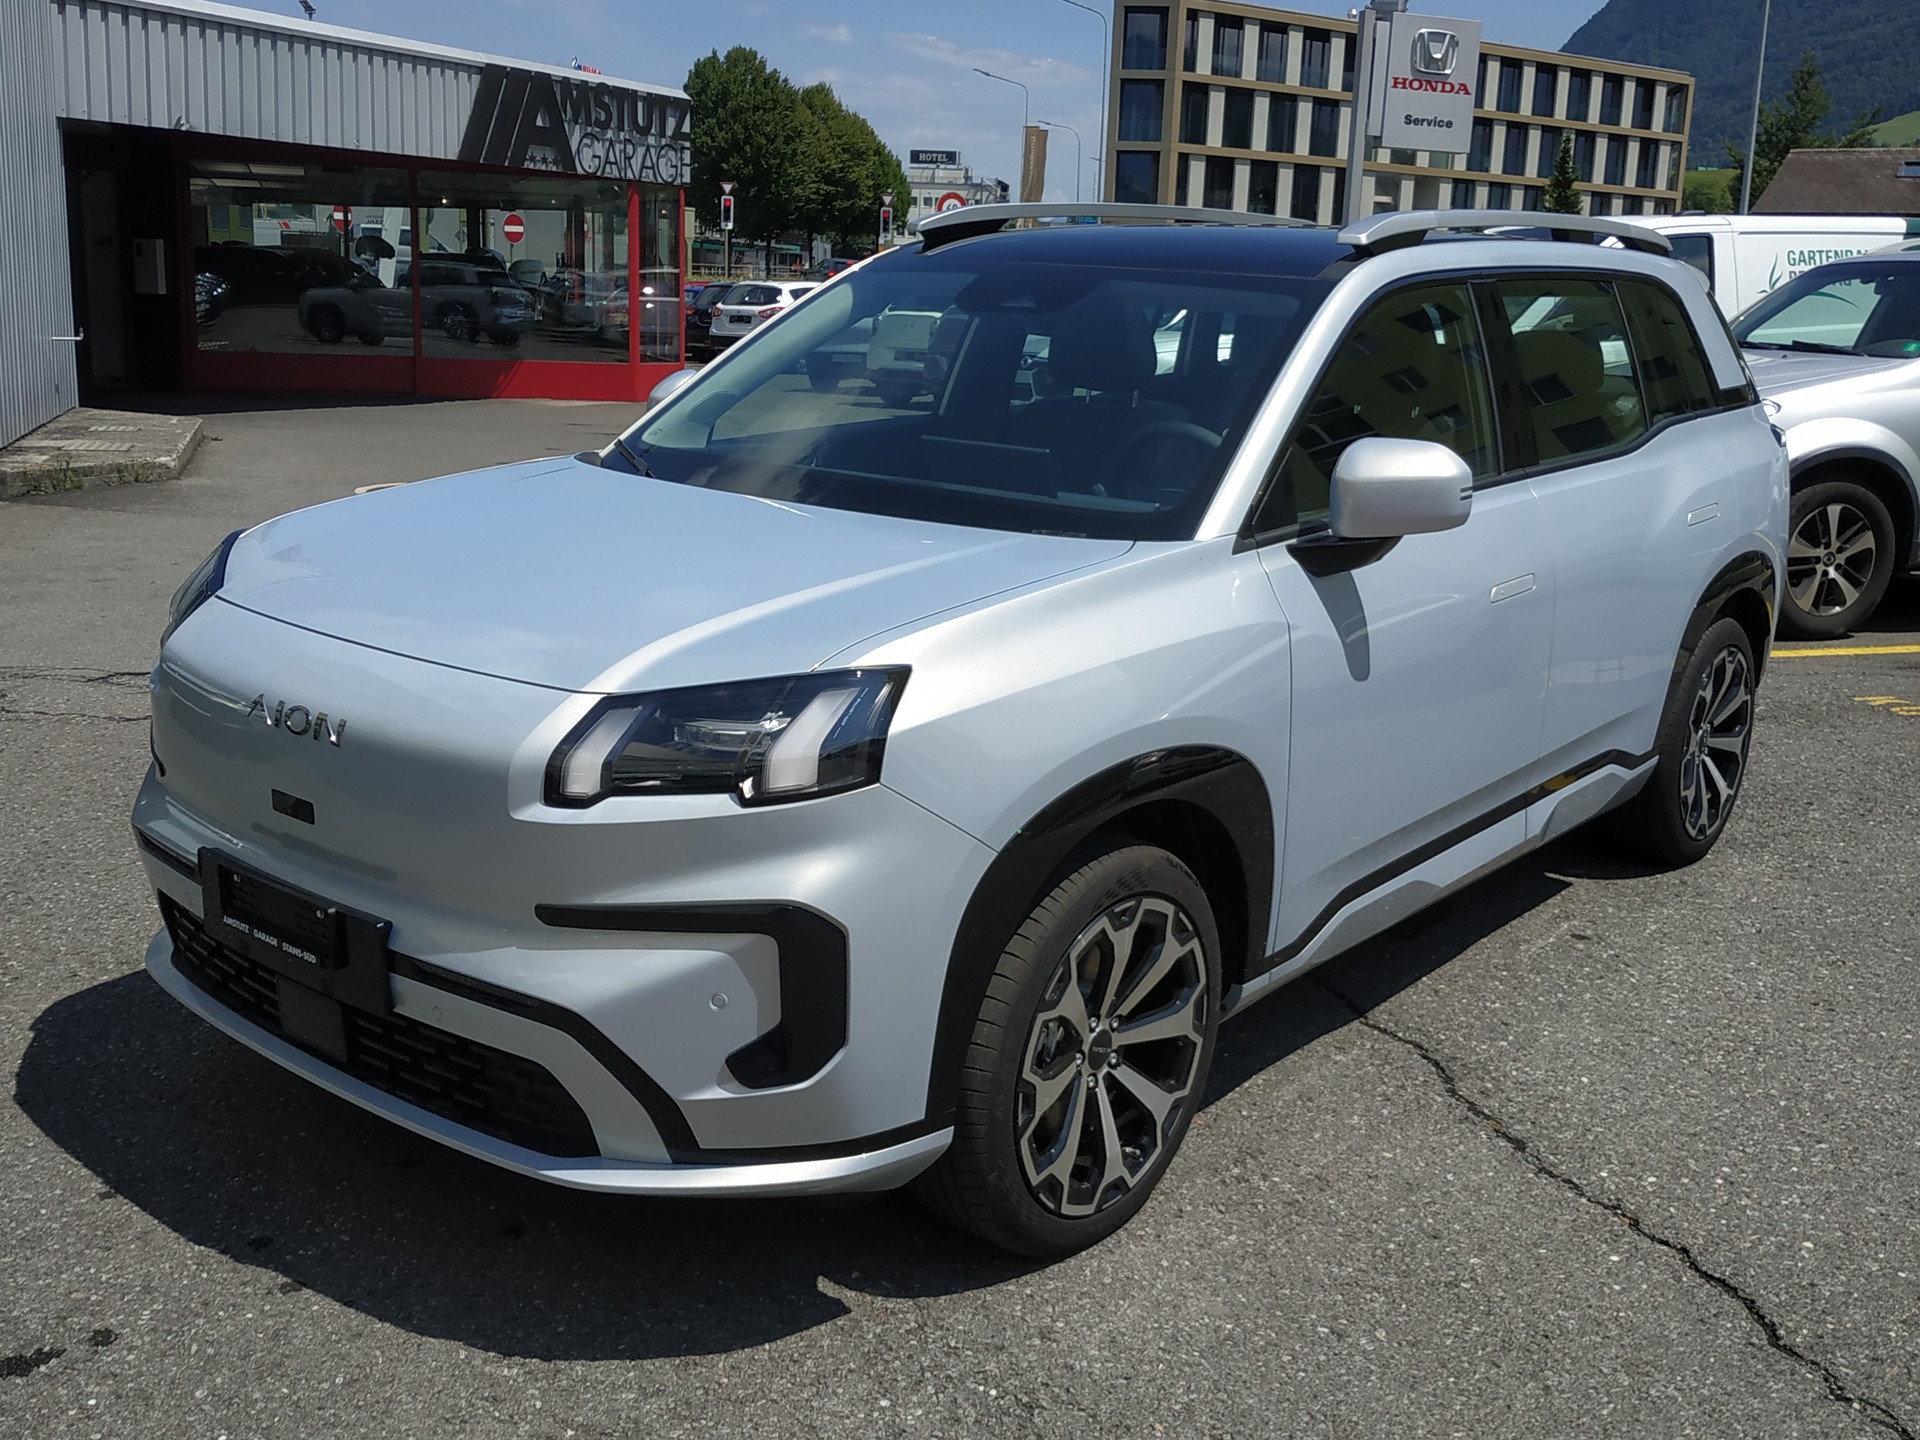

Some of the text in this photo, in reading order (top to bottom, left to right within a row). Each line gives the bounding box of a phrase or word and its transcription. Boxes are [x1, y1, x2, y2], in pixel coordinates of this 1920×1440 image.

[1391, 77, 1472, 95] HONDA
[505, 70, 692, 172] AMSTUTZ
[1404, 114, 1453, 129] Service
[577, 132, 692, 187] GARAGE
[919, 153, 948, 162] HOTEL
[247, 693, 347, 748] AION
[223, 915, 250, 934] AMSTUTZ
[253, 928, 279, 947] GARAGE
